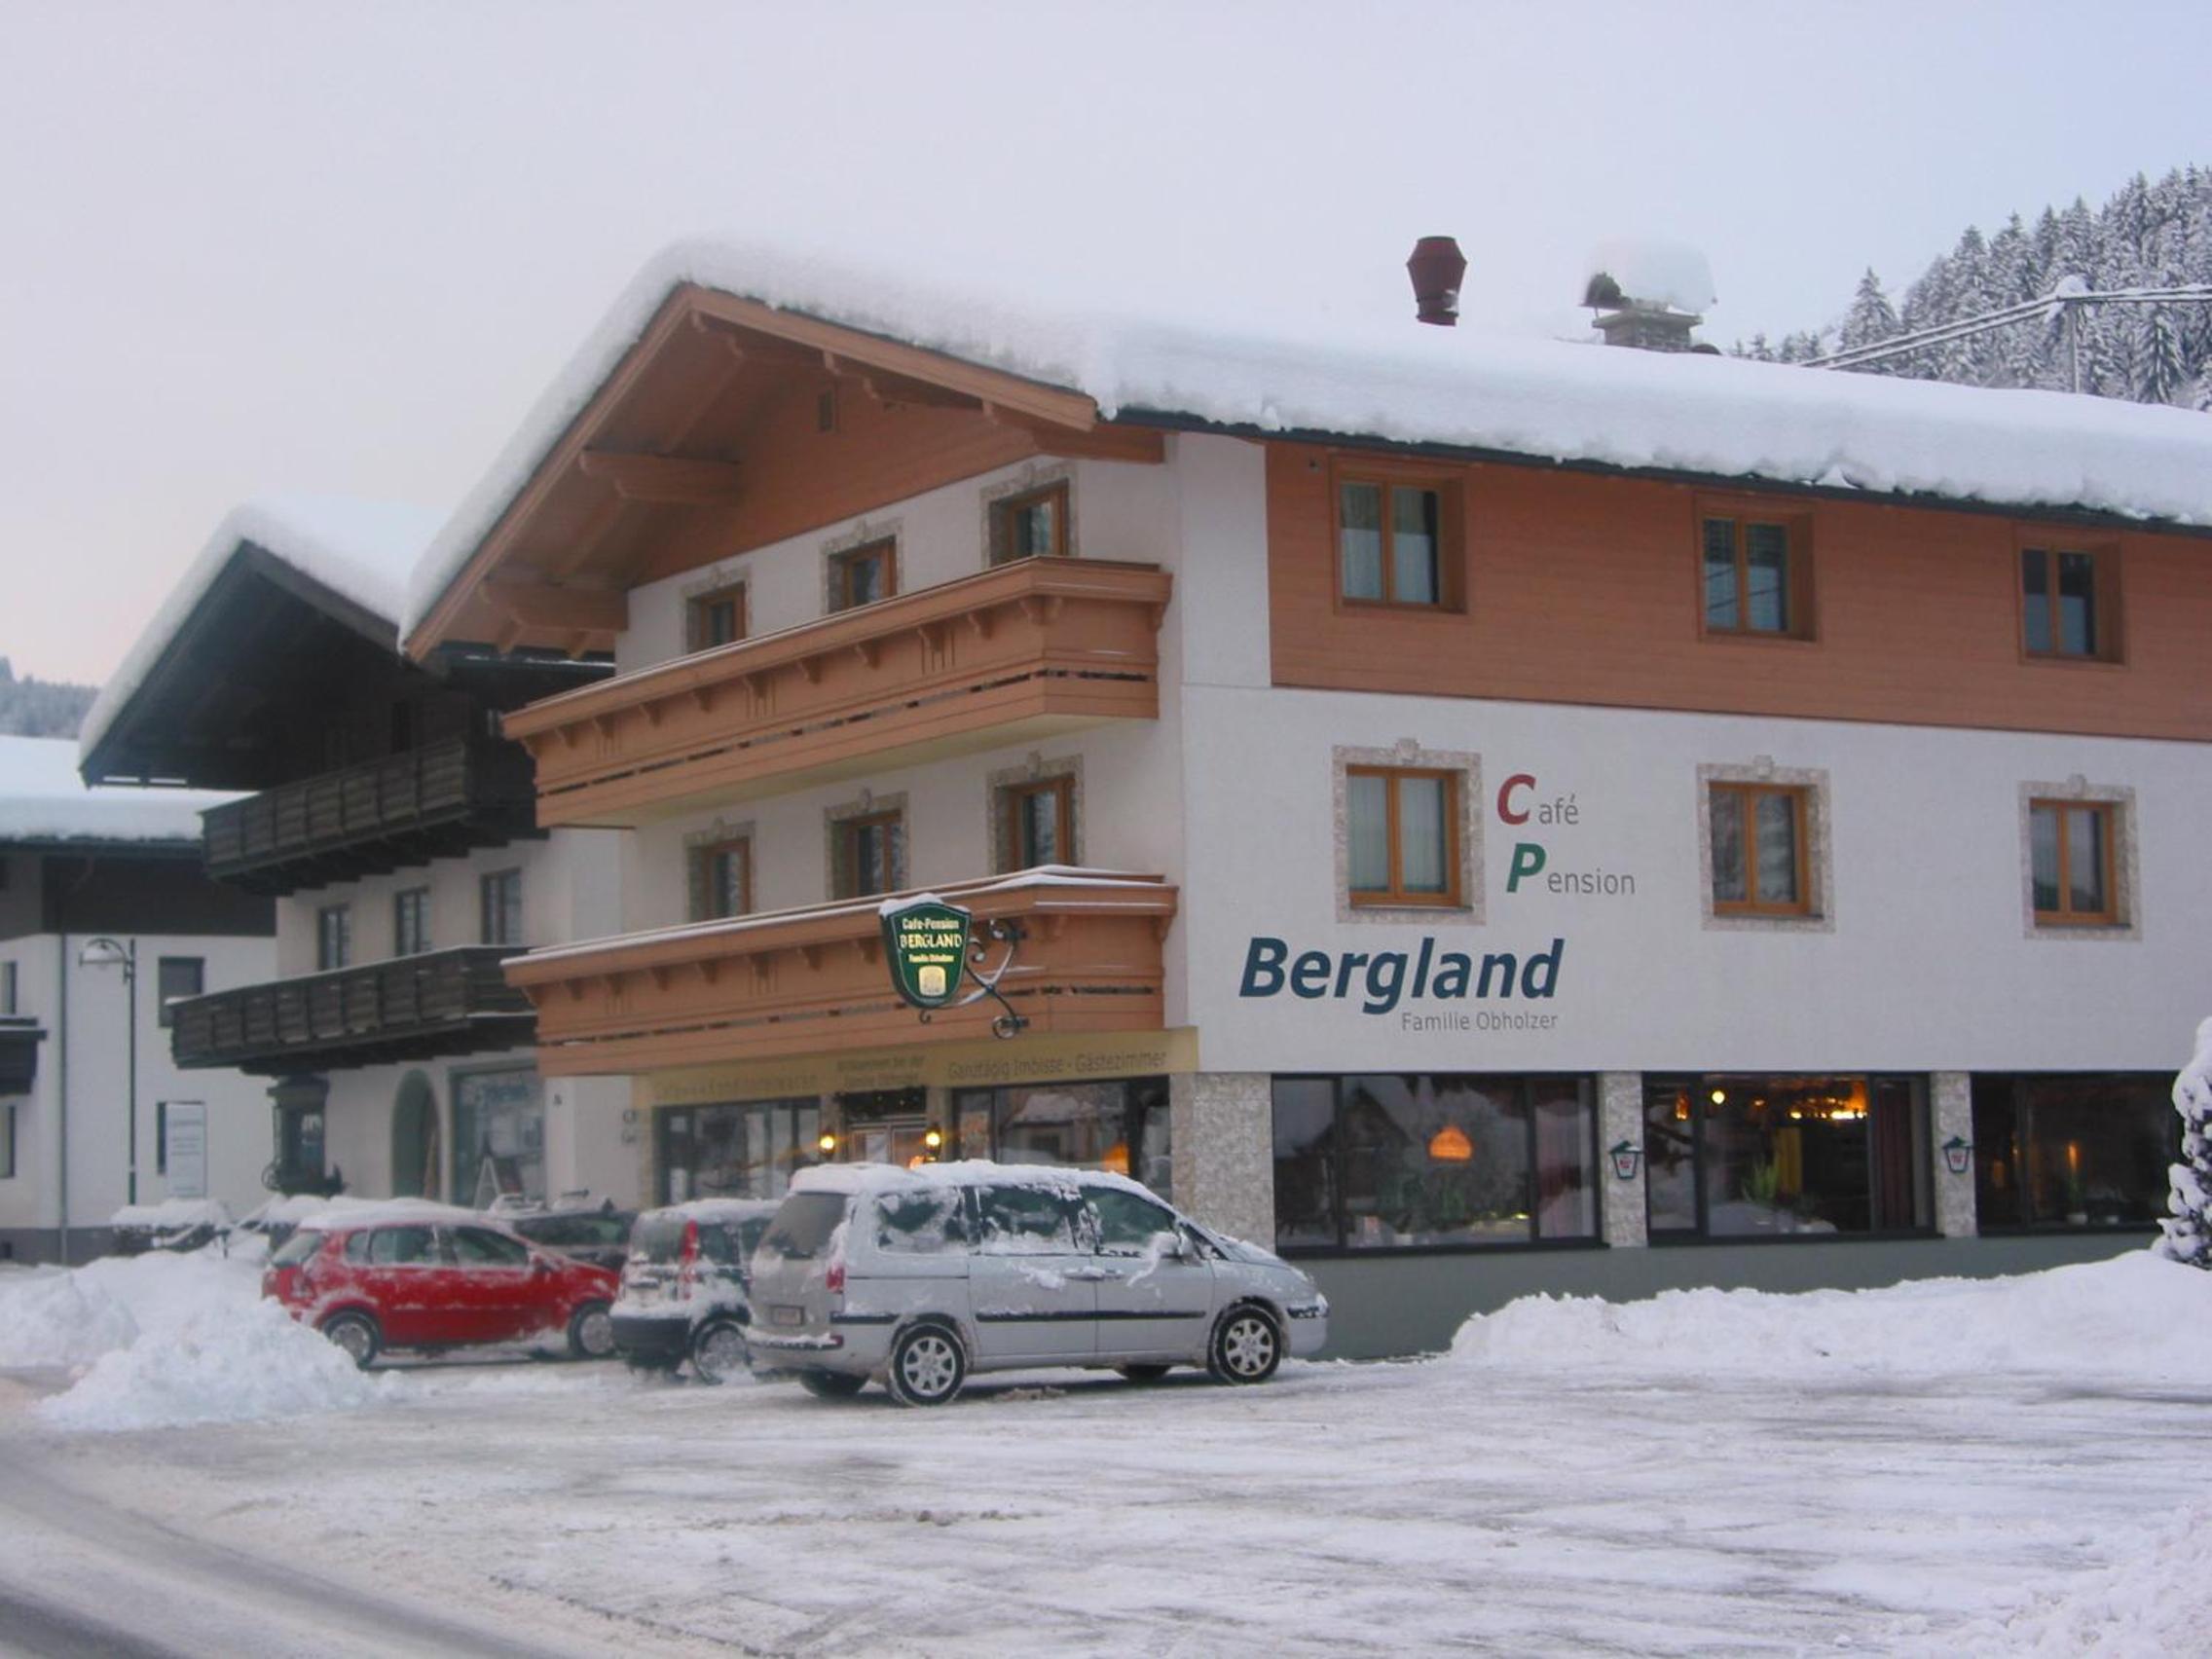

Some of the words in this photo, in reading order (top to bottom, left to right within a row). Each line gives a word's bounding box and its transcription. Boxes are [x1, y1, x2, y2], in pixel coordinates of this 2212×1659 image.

[1496, 773, 1579, 825] Café
[1506, 842, 1636, 895] Pension
[900, 933, 962, 948] BERGLAND
[1238, 937, 1566, 1014] Bergland
[1402, 1012, 1470, 1031] Familie
[1476, 1013, 1559, 1032] Obholzer
